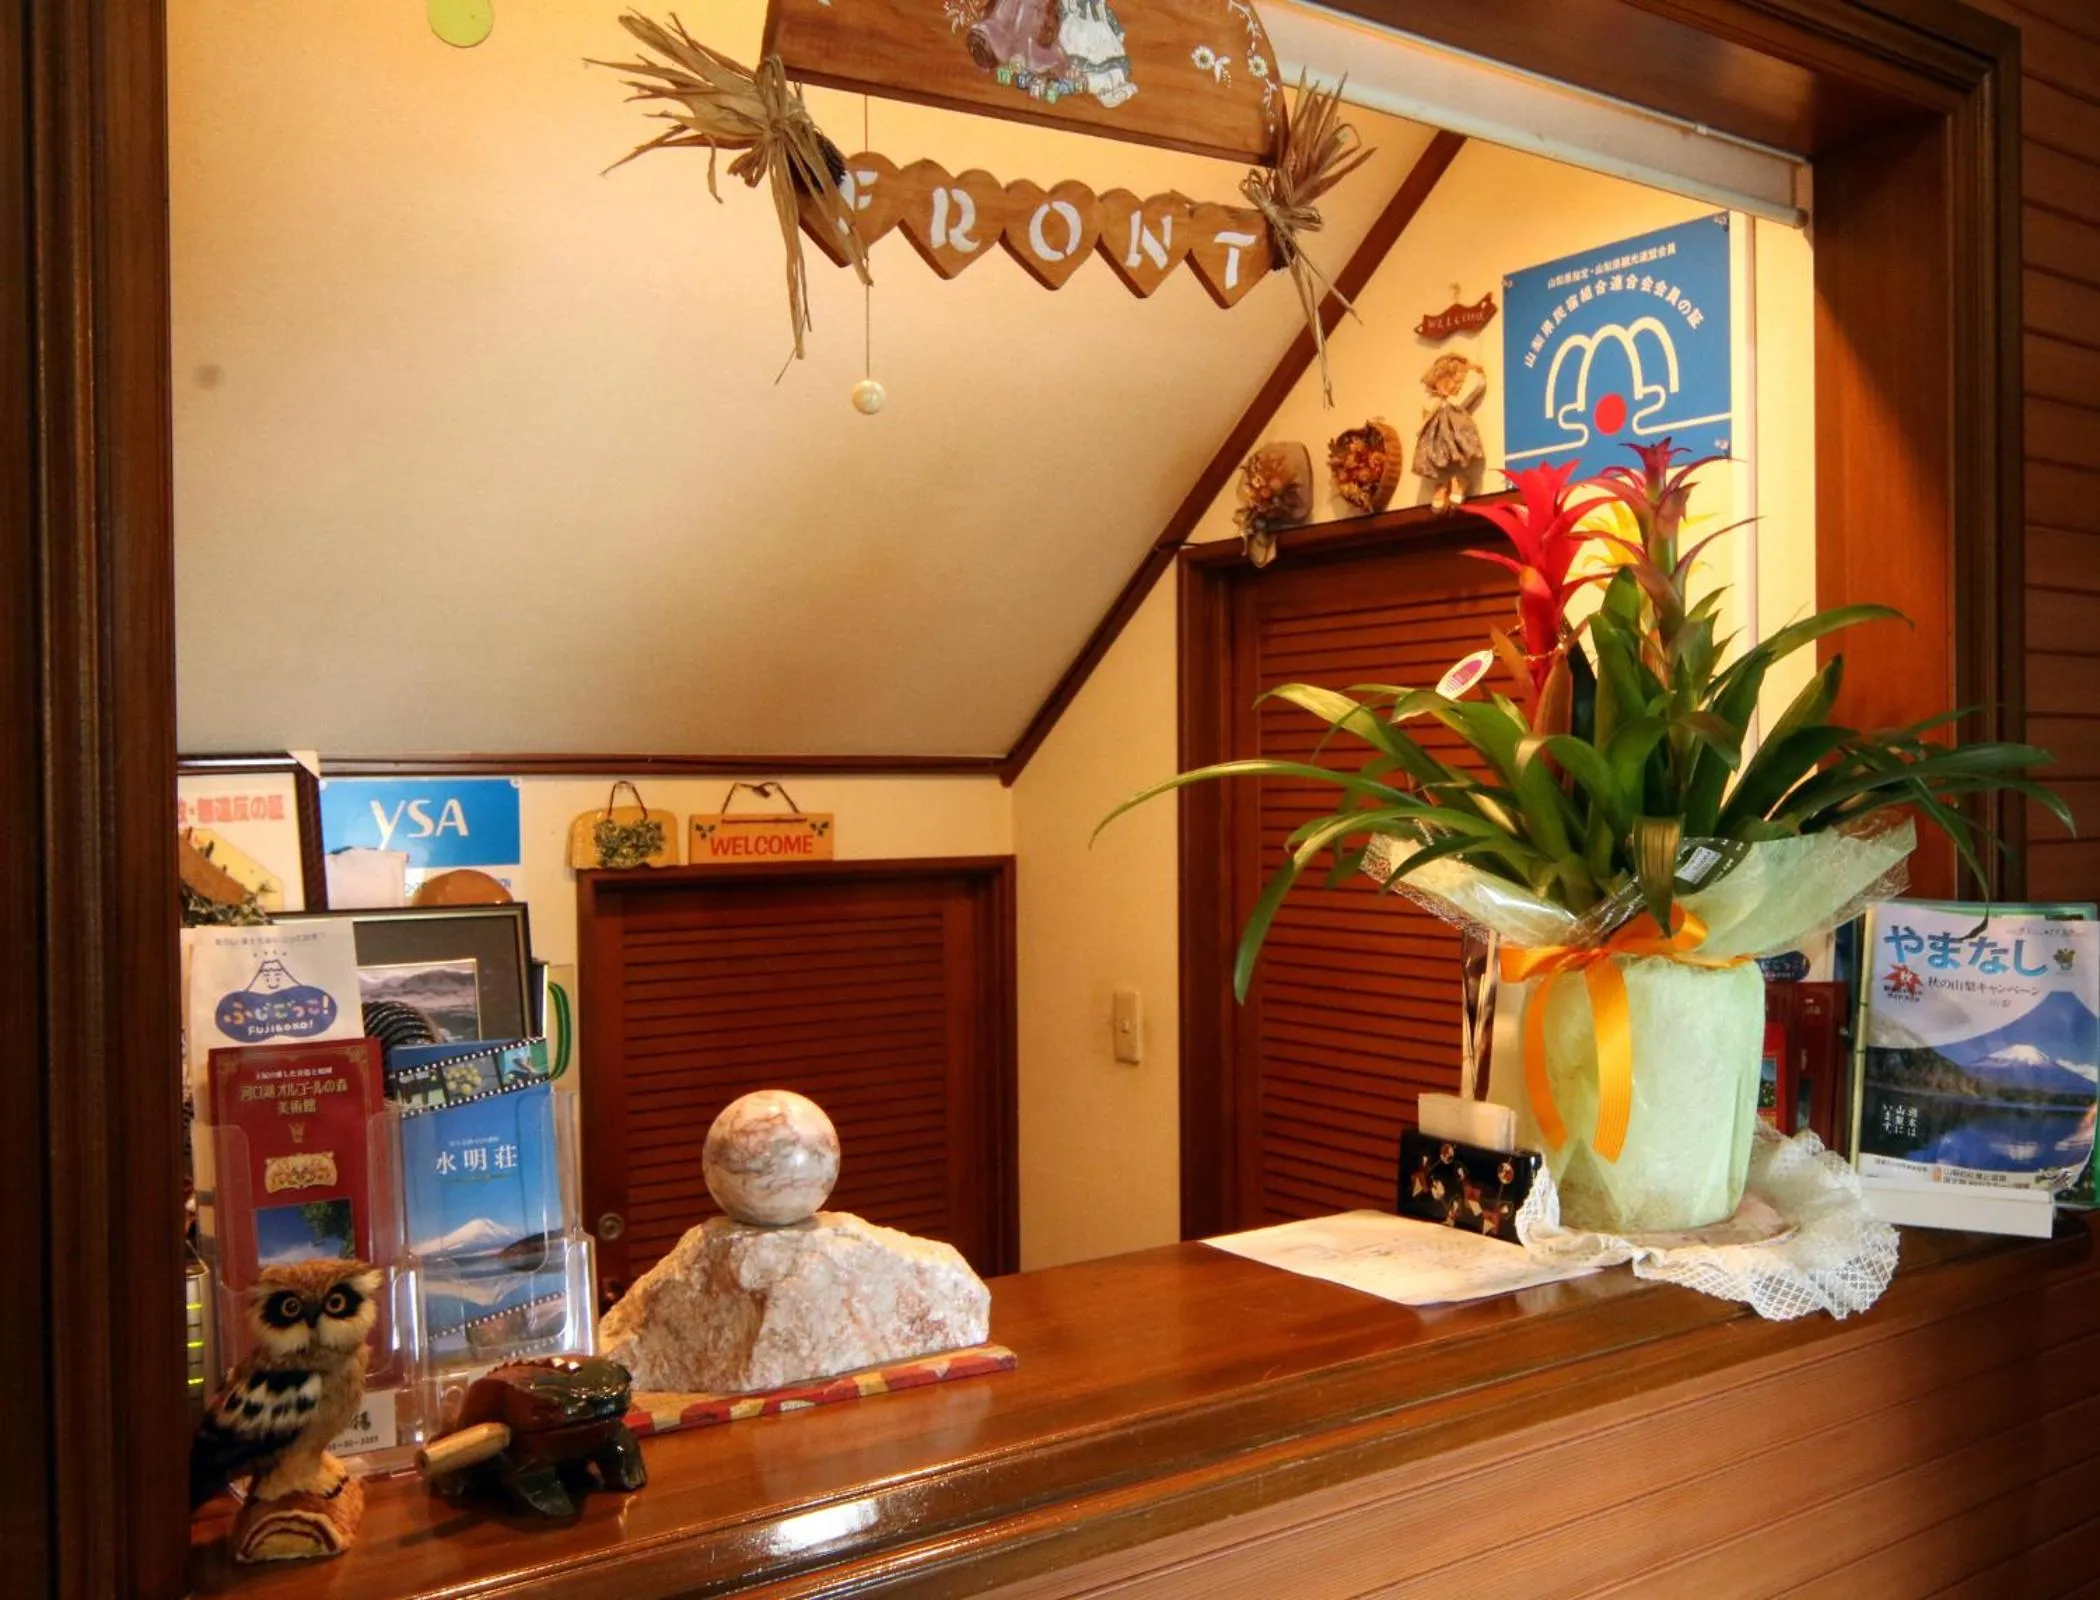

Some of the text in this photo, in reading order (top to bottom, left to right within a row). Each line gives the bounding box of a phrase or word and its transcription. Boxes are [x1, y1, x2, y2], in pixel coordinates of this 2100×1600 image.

[838, 170, 1257, 290] FRONT
[710, 835, 815, 856] WELCOME
[1884, 925, 2049, 978] やまなし
[435, 1143, 518, 1176] 水明荘
